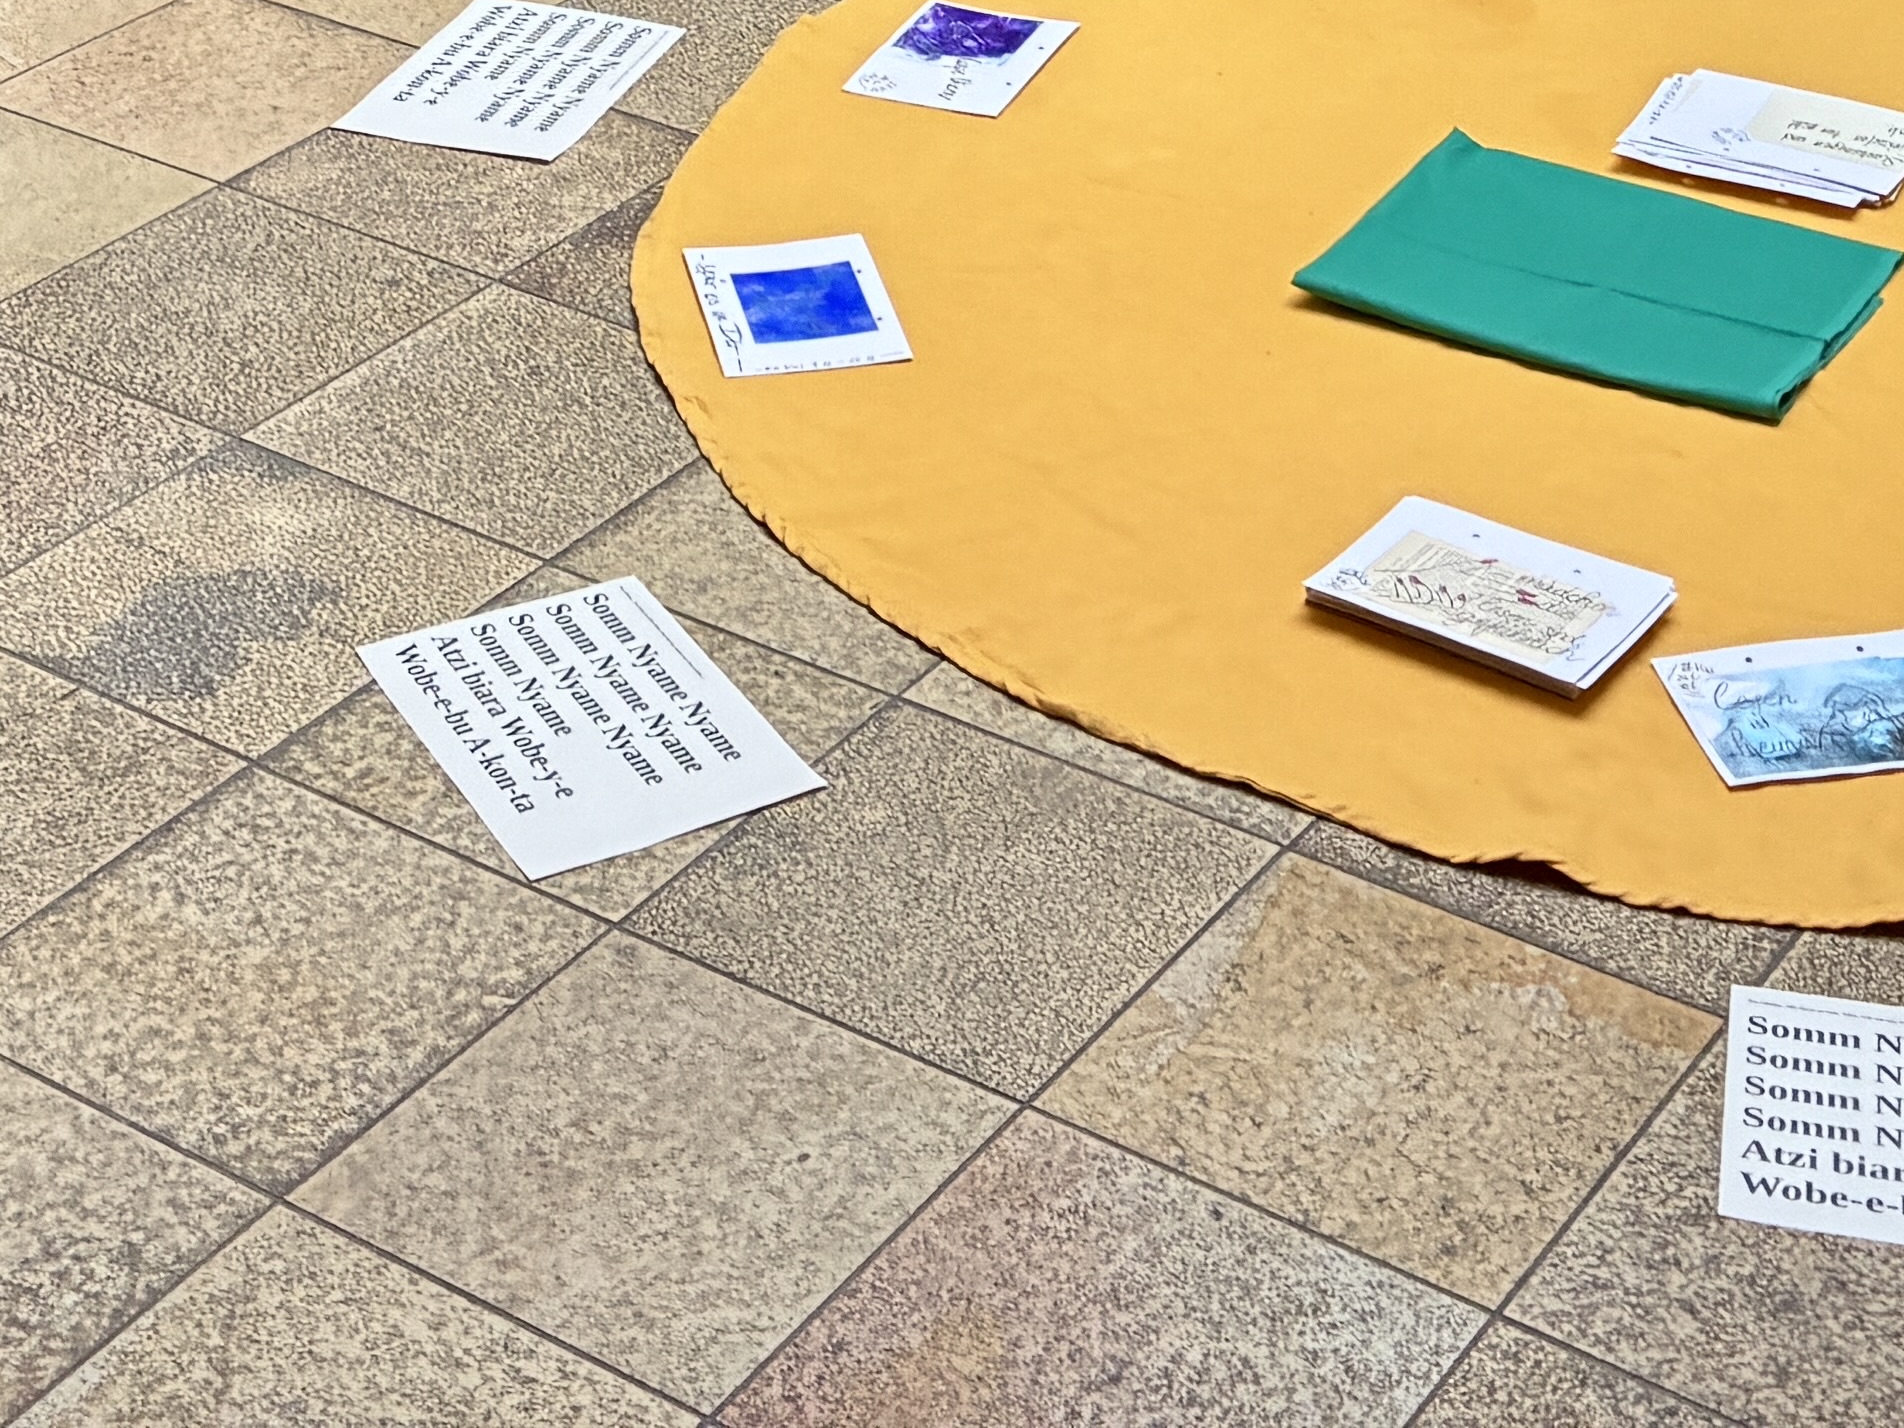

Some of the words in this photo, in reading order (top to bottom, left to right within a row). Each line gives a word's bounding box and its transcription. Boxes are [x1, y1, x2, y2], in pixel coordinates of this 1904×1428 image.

[395, 642, 474, 736] Wobe-e-bu
[462, 738, 535, 814] A-kon-ta
[430, 636, 478, 673] Atzi
[460, 669, 507, 718] biara
[500, 715, 574, 800] Wobe-y-e
[470, 623, 523, 678] Somm
[512, 676, 572, 737] Nyame
[508, 613, 561, 667] Somm
[551, 665, 611, 726] Nyame
[601, 723, 663, 786] Nyame
[545, 603, 599, 656] Somm
[589, 653, 650, 714] Nyame
[640, 712, 703, 774] Nyame
[582, 592, 636, 645] Somm
[626, 642, 688, 702] Nyame
[678, 700, 742, 762] Nyame
[1745, 1045, 1862, 1080] Somm
[1747, 1015, 1861, 1050] Somm
[1742, 1106, 1861, 1144] Somm
[1744, 1075, 1861, 1112] Somm
[1741, 1139, 1818, 1171] Atzi
